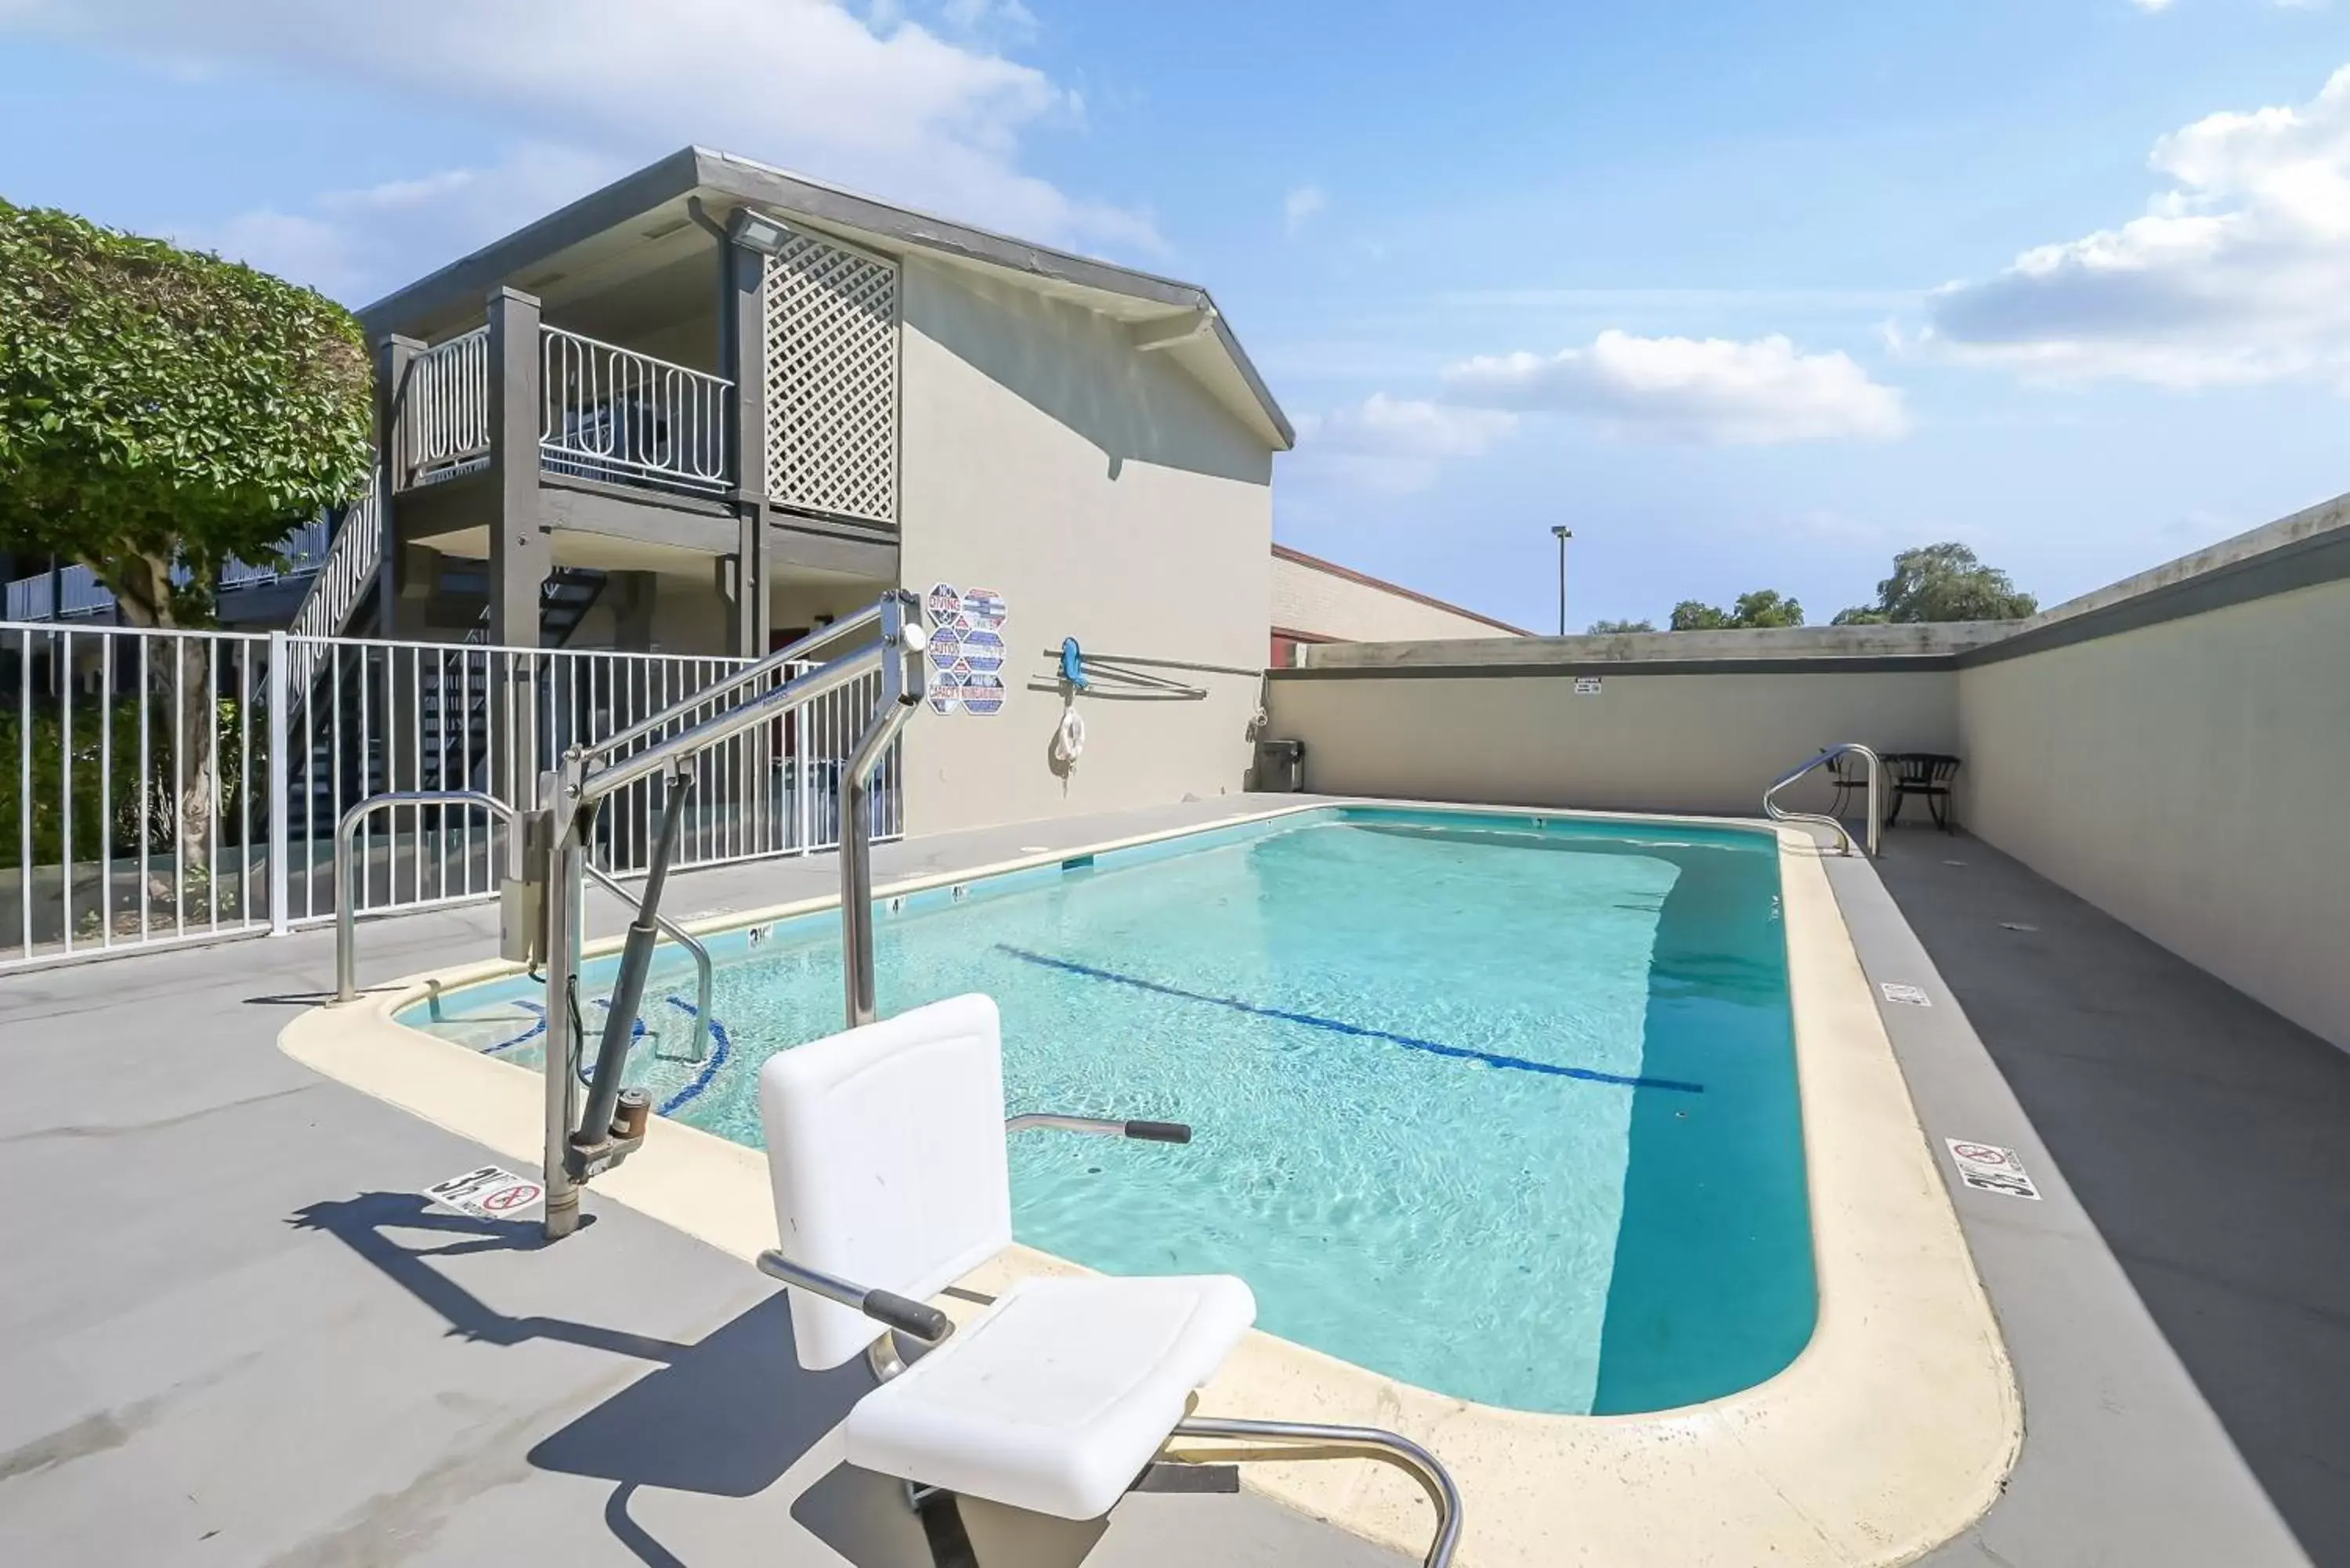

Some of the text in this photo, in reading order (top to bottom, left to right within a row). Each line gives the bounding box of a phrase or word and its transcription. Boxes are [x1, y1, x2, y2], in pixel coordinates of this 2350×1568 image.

[940, 583, 953, 597] NO
[928, 595, 960, 611] DIVING
[929, 642, 960, 656] CAUTION
[929, 684, 960, 698] CAPACITY
